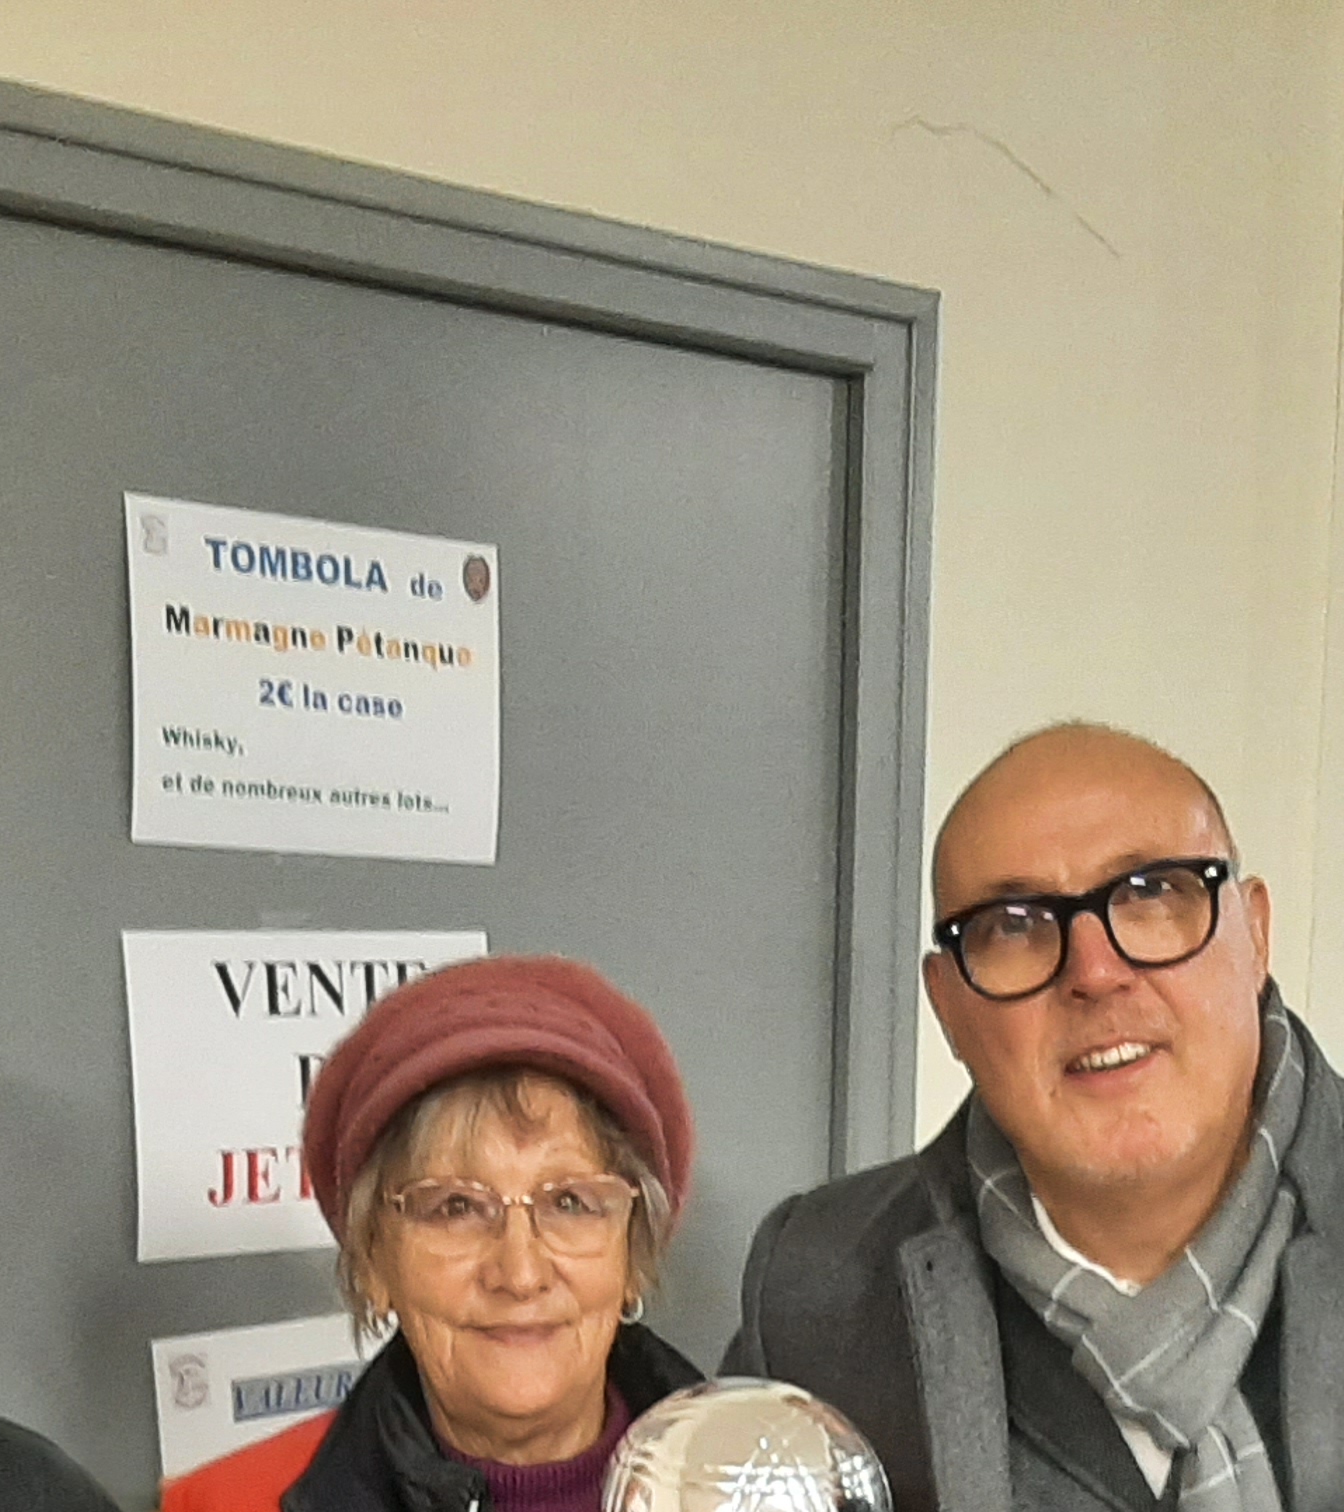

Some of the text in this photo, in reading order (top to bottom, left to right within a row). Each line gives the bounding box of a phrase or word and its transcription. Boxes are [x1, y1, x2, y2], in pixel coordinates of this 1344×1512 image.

[204, 536, 444, 601] TOMBOLA de
[165, 604, 474, 670] Marmagne Pétanque
[258, 678, 404, 719] 2€ la case
[161, 726, 244, 757] Whisky,
[161, 772, 183, 795] et
[190, 773, 215, 795] de
[222, 776, 323, 805] nombreux
[330, 787, 392, 809] autres
